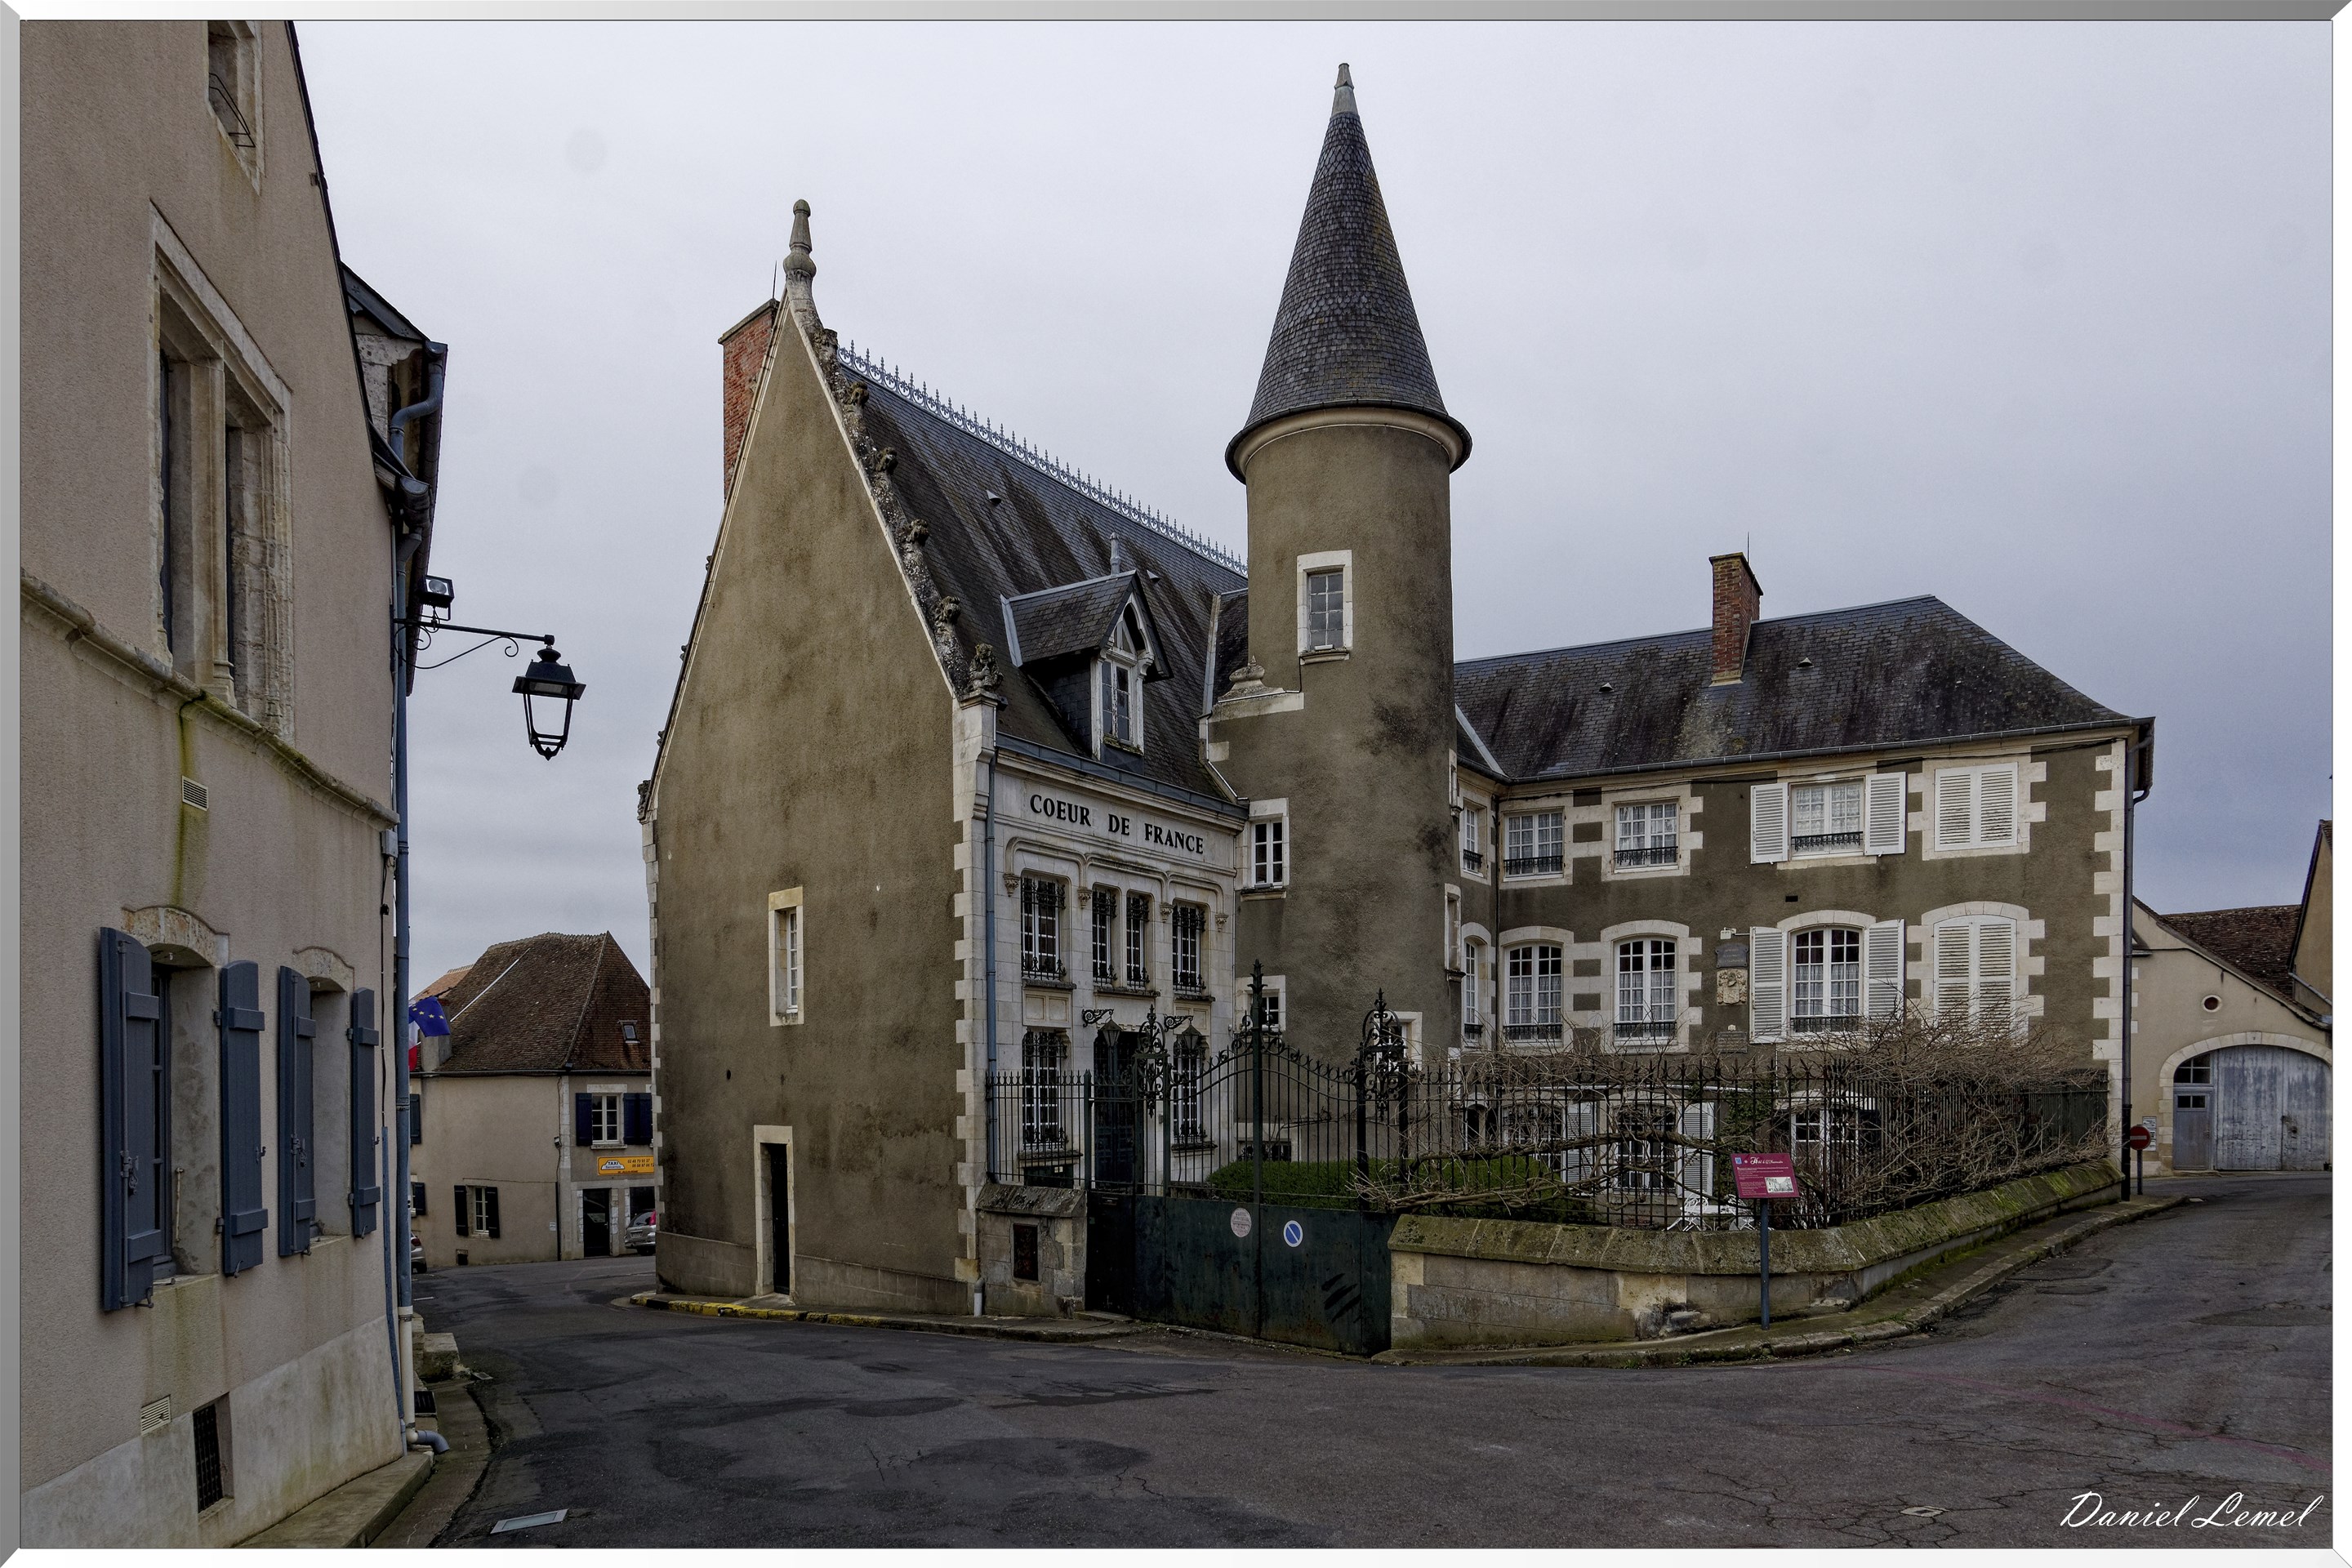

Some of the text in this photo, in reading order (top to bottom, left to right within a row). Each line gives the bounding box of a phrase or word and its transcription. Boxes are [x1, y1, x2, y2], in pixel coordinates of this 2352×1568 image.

[1030, 794, 1204, 854] COEUR DE FRANCE
